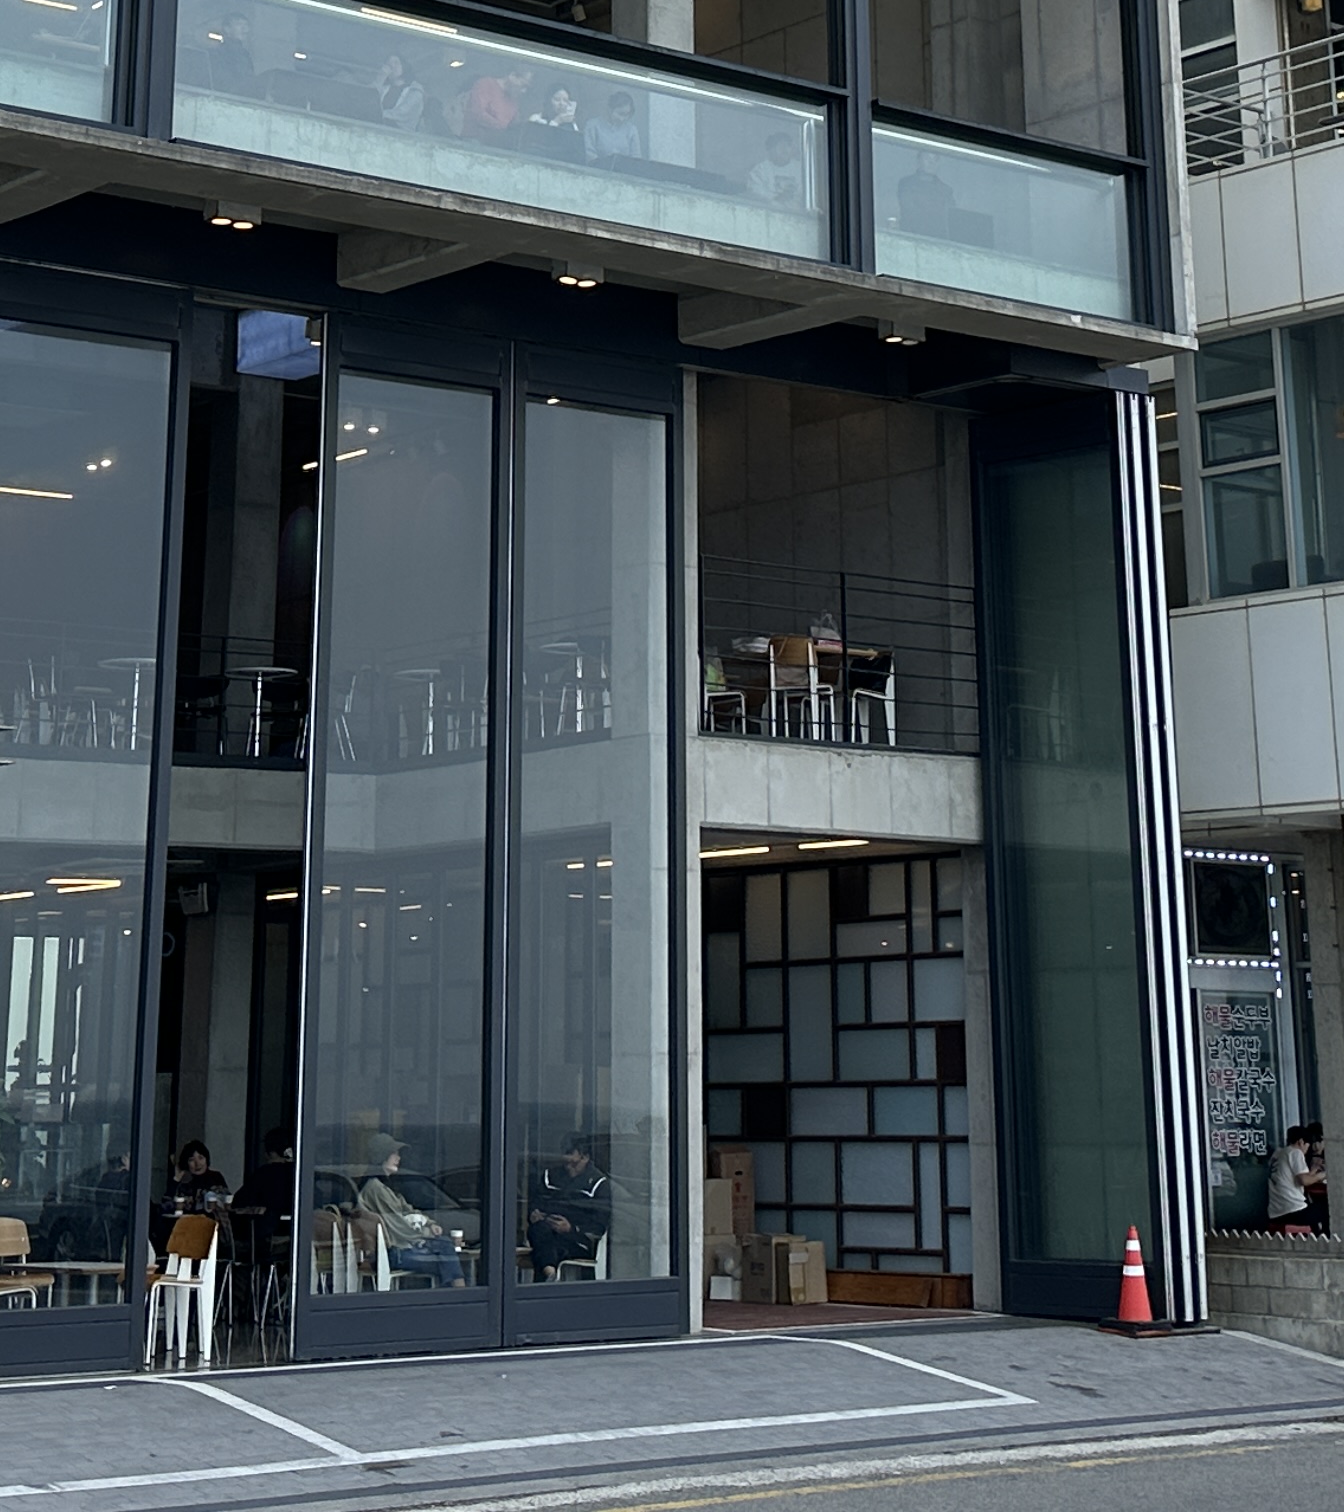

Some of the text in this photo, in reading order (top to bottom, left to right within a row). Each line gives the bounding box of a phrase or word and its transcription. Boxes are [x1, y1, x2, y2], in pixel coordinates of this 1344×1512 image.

[1204, 1003, 1272, 1031] 해물순두부
[1207, 1034, 1262, 1062] 날치알밥
[1208, 1066, 1277, 1094] 해물칼국수
[1212, 1128, 1268, 1156] 해물라면
